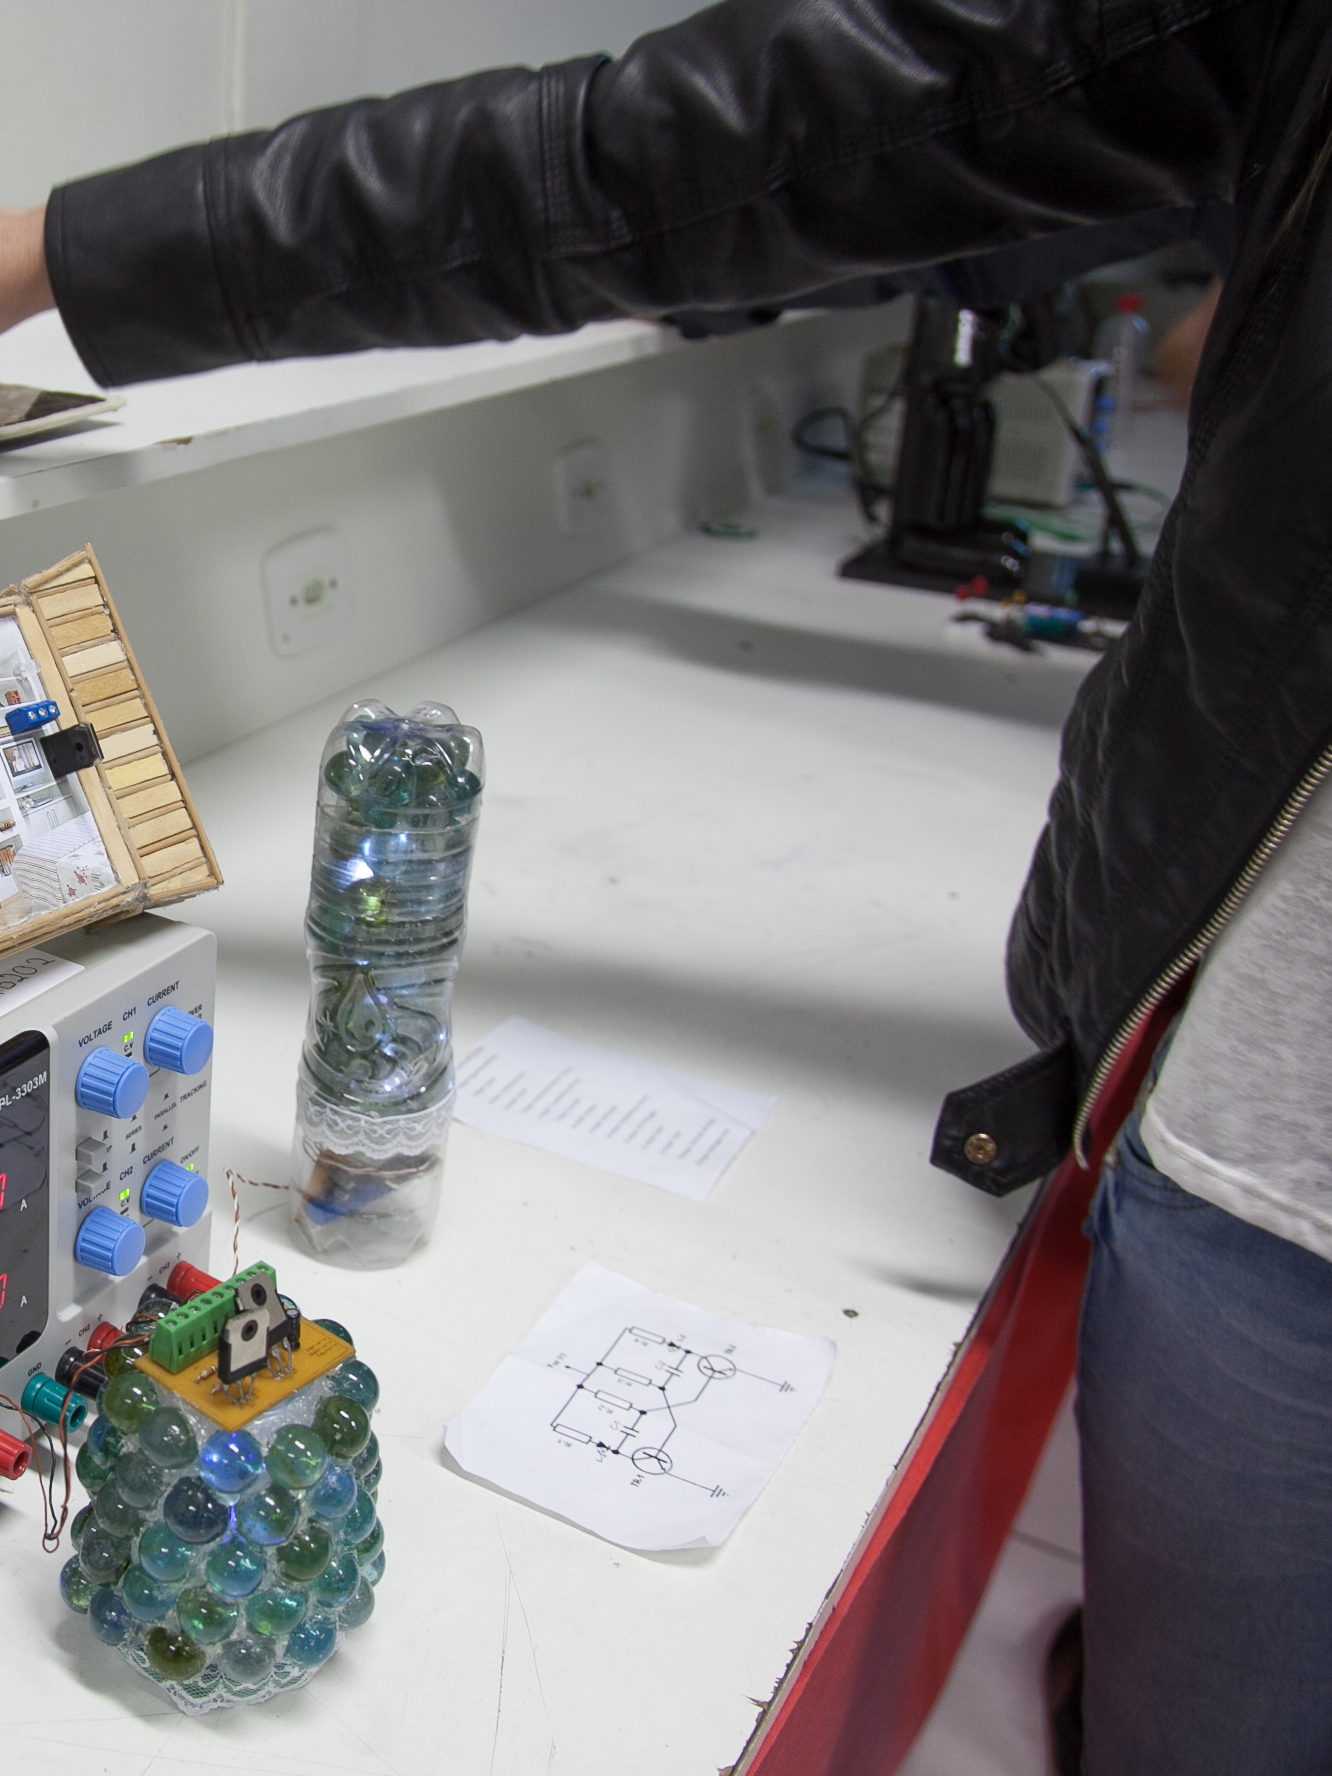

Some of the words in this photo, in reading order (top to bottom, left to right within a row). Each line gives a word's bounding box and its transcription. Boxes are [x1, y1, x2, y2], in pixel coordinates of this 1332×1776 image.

[147, 981, 180, 1006] CURRENT
[122, 1007, 137, 1021] CH1
[78, 1020, 113, 1048] VOLTAGE
[179, 1080, 208, 1103] TRACKING
[125, 1125, 142, 1140] SERIES
[142, 1136, 175, 1165] CURRENT
[119, 1165, 134, 1181] CH2
[78, 1181, 111, 1210] VOLE
[20, 1199, 29, 1212] A
[20, 1296, 29, 1308] A
[78, 1323, 91, 1338] CH2
[27, 1361, 43, 1377] GND
